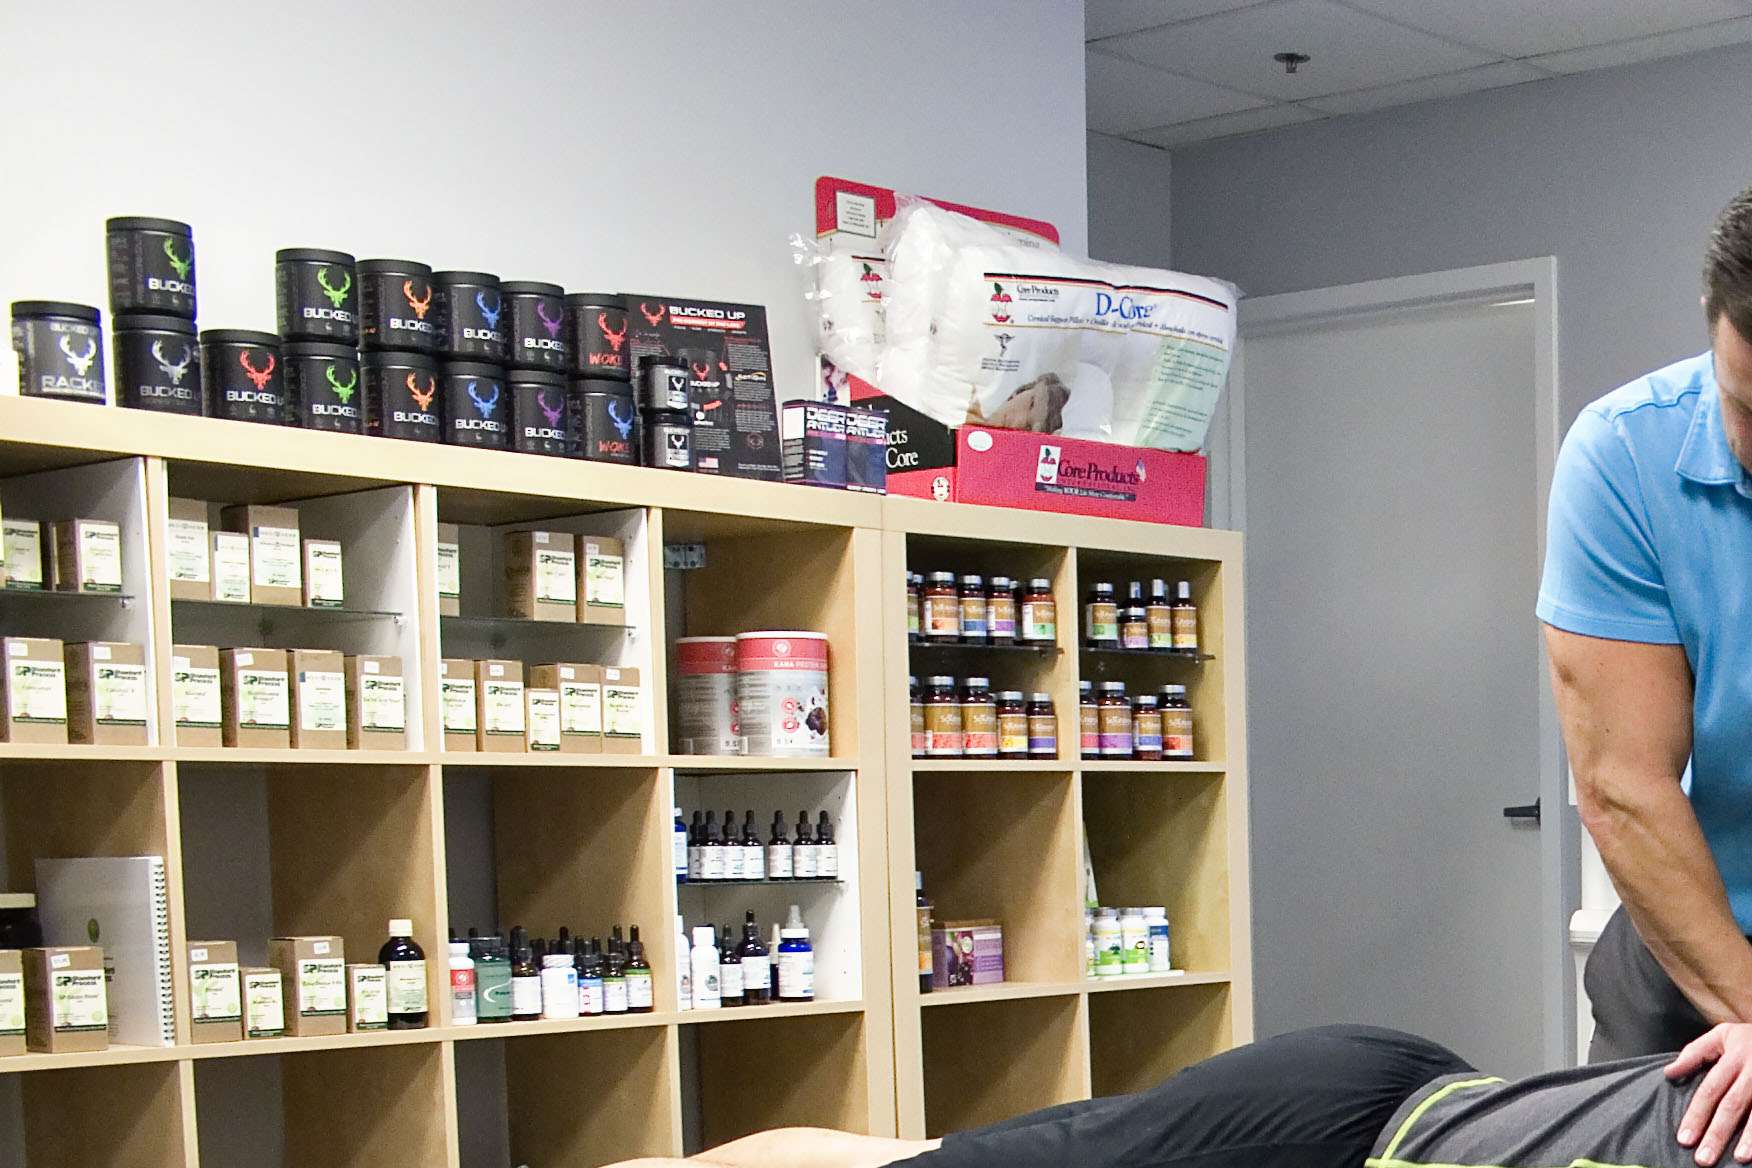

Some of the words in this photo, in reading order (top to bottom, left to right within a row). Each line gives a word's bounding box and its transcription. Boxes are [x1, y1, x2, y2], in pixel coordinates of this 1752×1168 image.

[668, 305, 725, 319] BUCKED
[726, 309, 746, 320] UP
[140, 385, 193, 399] BUCKED
[226, 390, 277, 404] BUCKED
[806, 406, 847, 426] DEER
[846, 412, 889, 430] DEER
[455, 418, 501, 432] BUCKED
[806, 420, 845, 434] ANTLER
[885, 446, 919, 468] Core
[1057, 459, 1087, 479] Core
[1086, 463, 1140, 486] Products
